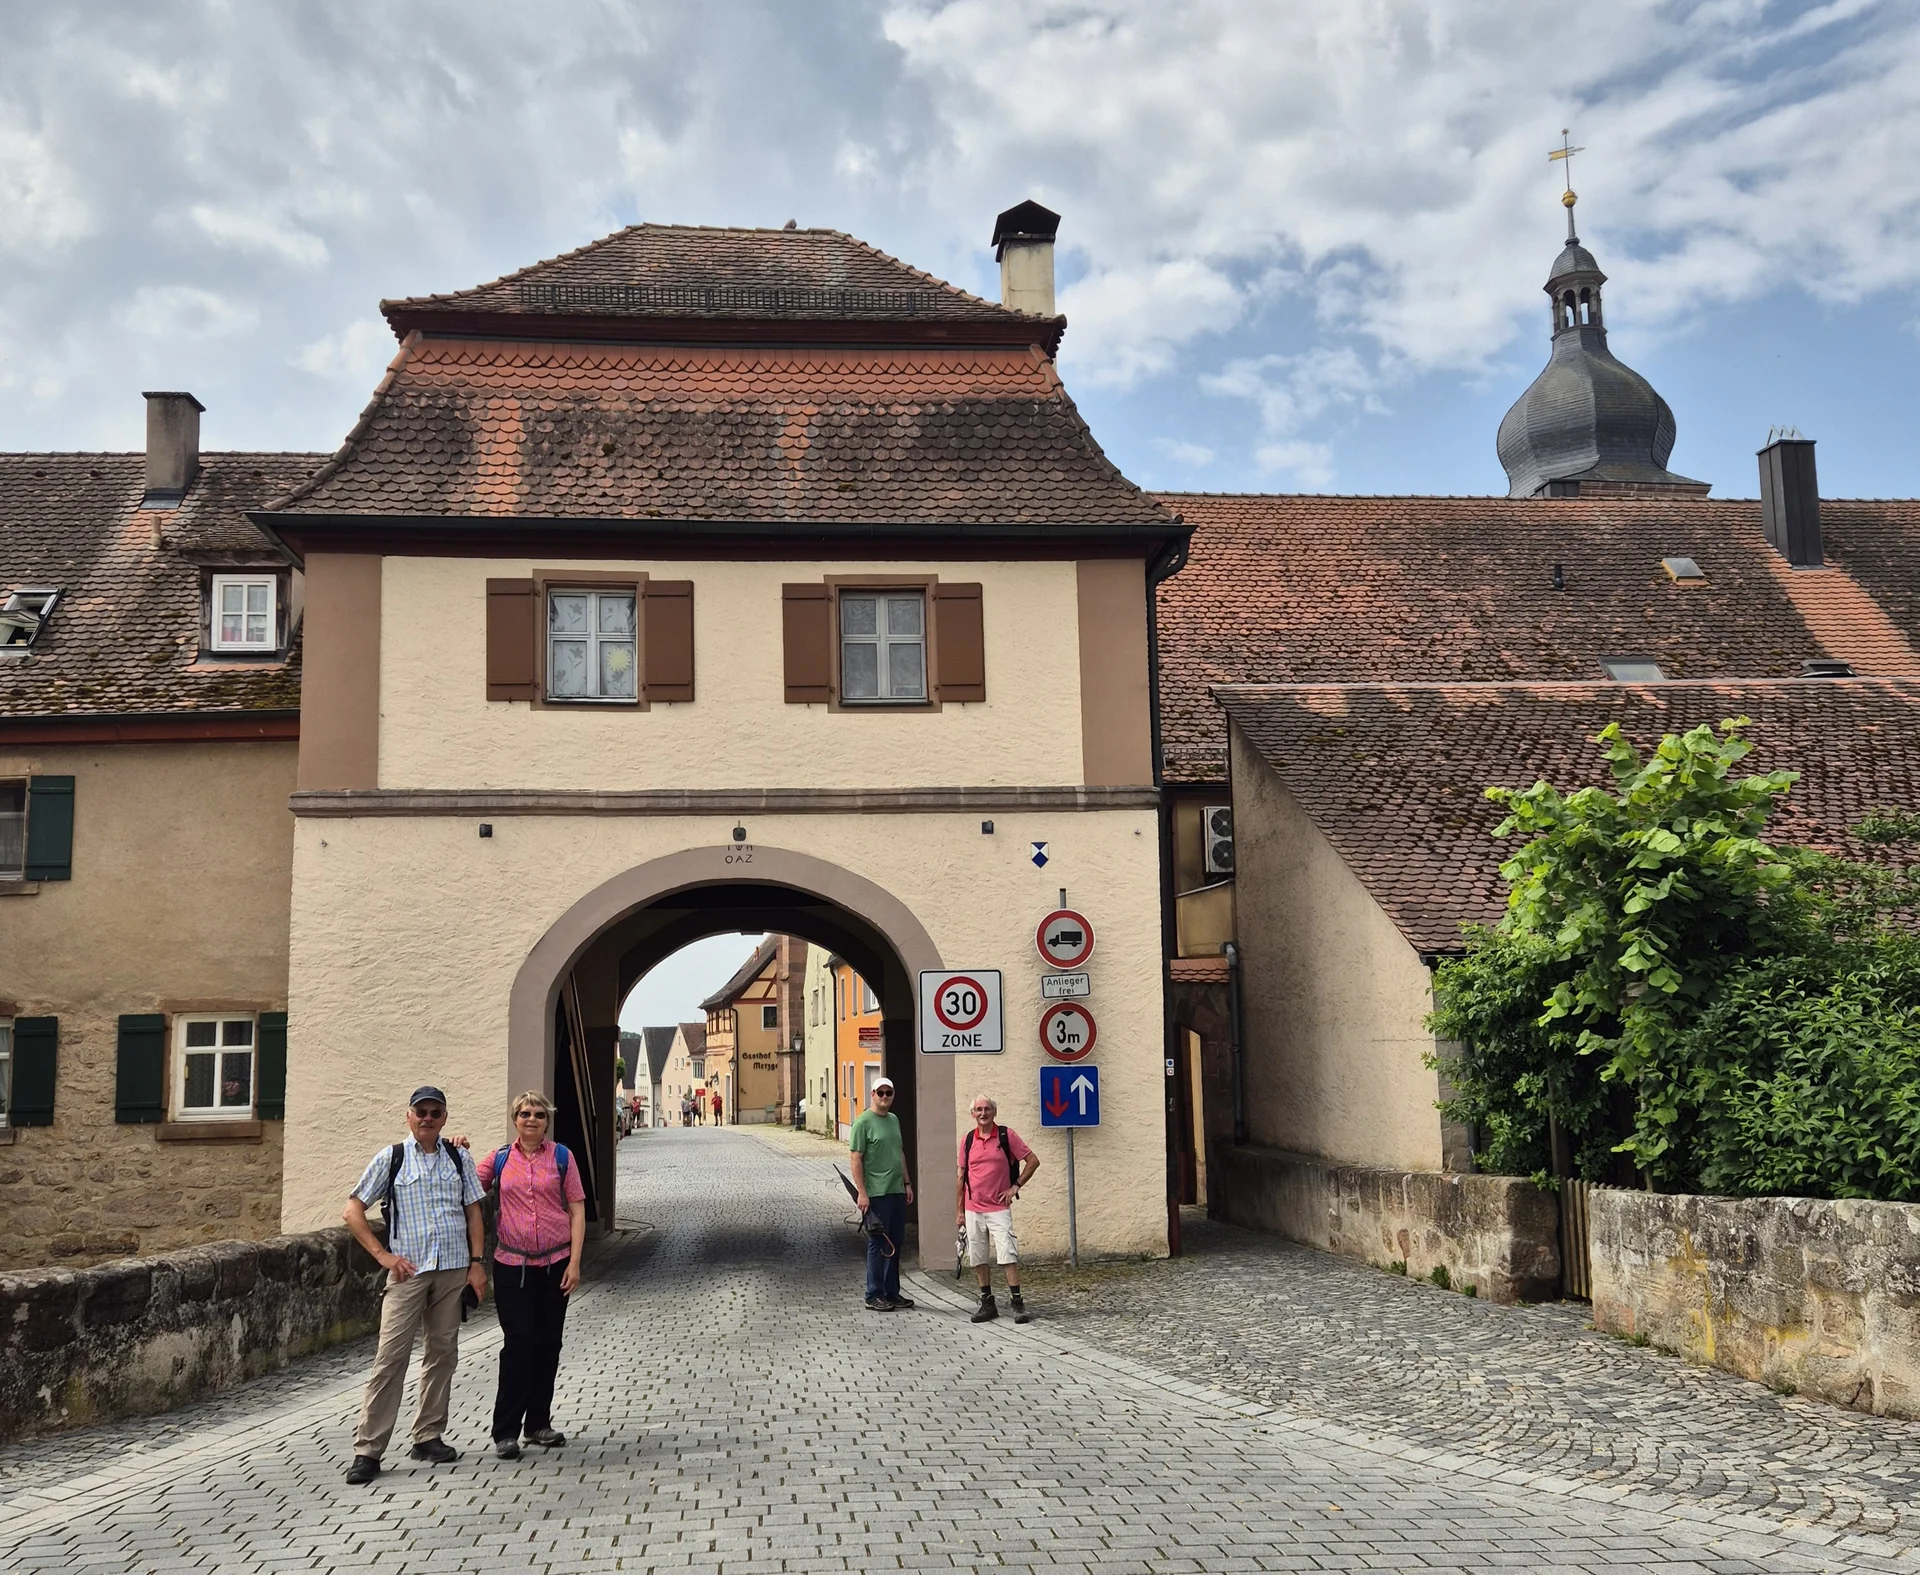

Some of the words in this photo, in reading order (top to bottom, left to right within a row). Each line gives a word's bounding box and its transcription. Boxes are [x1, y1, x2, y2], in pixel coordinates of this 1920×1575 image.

[1046, 977, 1085, 987] Anlieger
[1059, 987, 1075, 995] frei
[946, 991, 977, 1016] 30
[942, 1034, 982, 1047] ZONE
[741, 1052, 771, 1060] Gasthof
